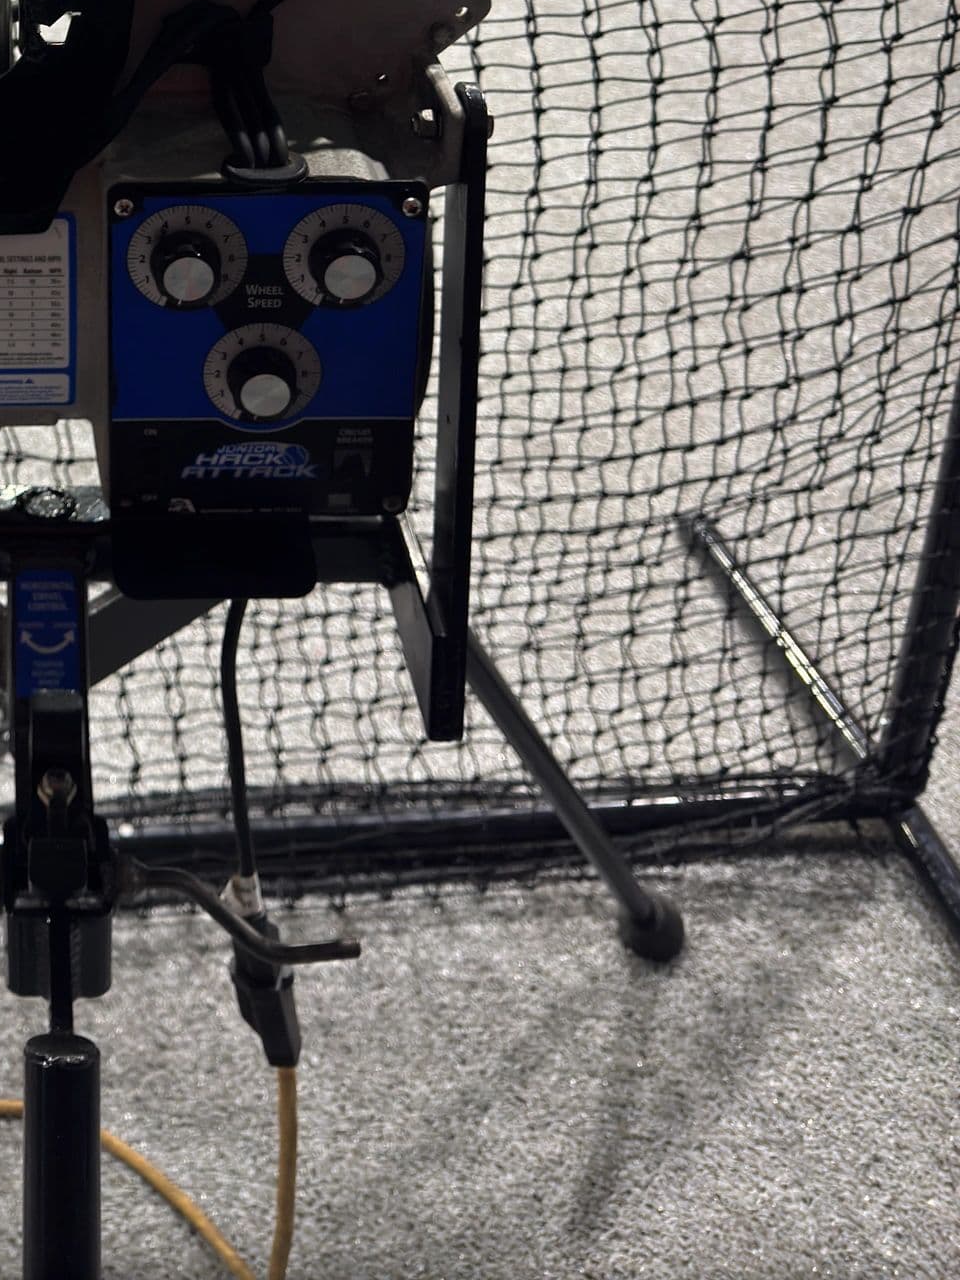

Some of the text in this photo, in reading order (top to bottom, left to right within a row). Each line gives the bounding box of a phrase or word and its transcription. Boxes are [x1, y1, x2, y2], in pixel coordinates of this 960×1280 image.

[246, 284, 283, 296] WHEEL
[247, 297, 282, 309] SPEED
[216, 443, 276, 454] JUNIOR
[194, 453, 285, 465] HACK
[180, 465, 320, 480] ATTACK
